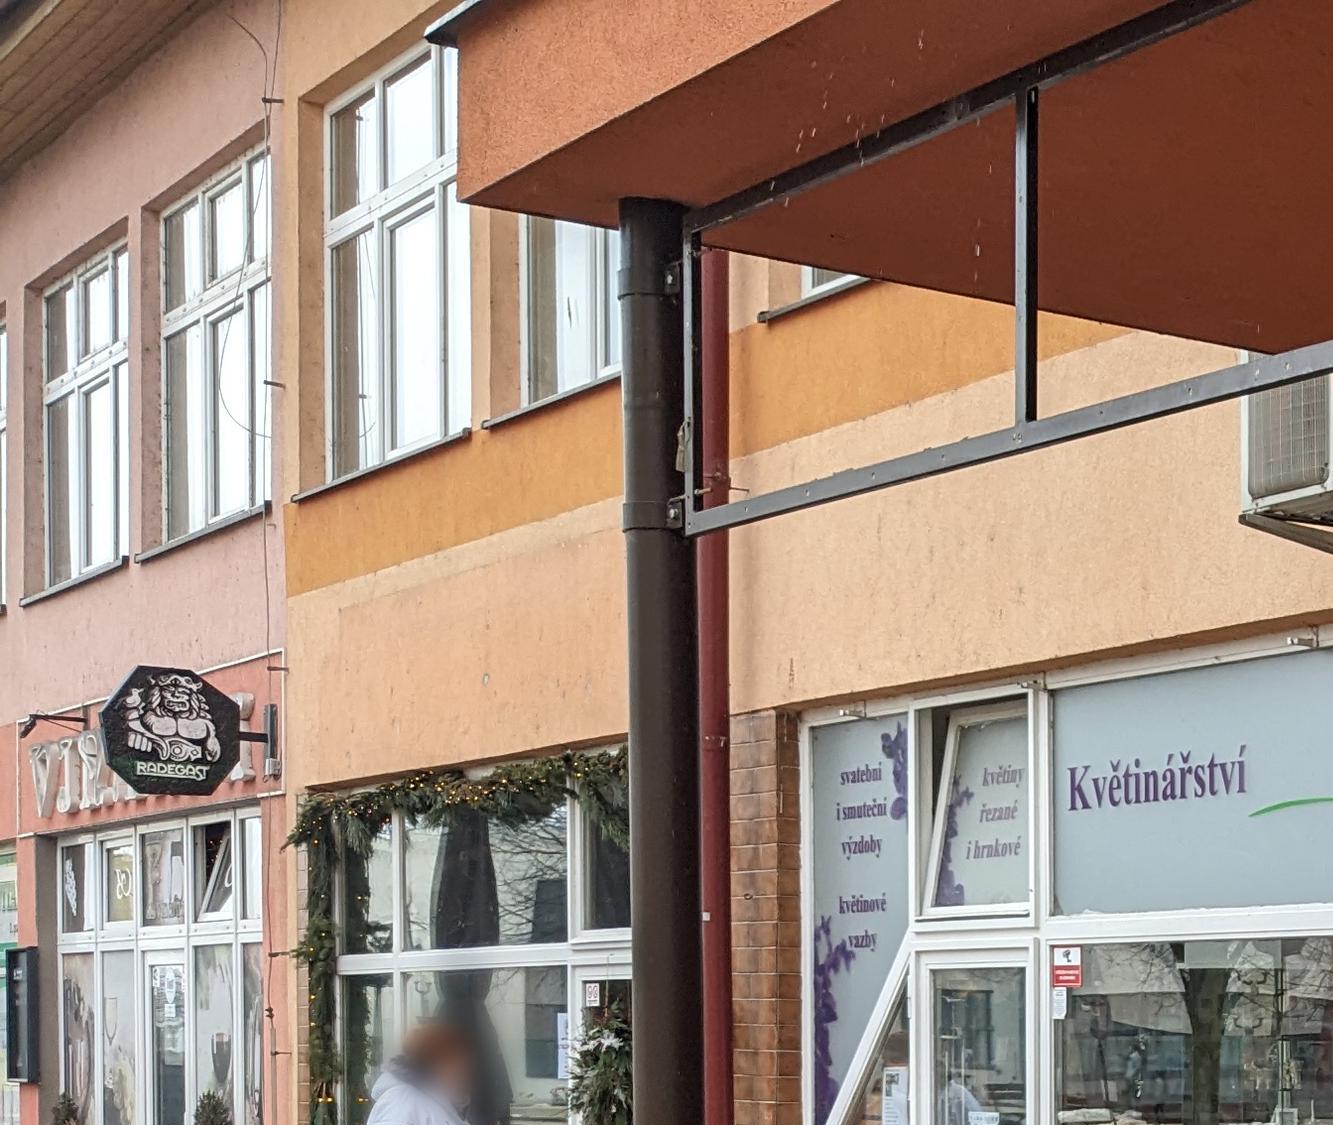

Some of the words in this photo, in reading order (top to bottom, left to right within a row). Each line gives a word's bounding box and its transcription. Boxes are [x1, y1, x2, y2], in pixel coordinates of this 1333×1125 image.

[136, 760, 211, 781] RADEGAST
[840, 761, 883, 786] svatební
[982, 764, 1025, 788] květiny
[1067, 744, 1247, 812] Květinářství
[836, 803, 841, 821] i
[842, 796, 888, 820] smuteční
[979, 800, 1019, 823] řezané
[841, 834, 883, 861] výzdoby
[966, 841, 972, 860] i
[973, 835, 1022, 860] hrnkové
[838, 892, 887, 914] květinové
[848, 929, 878, 952] vazby
